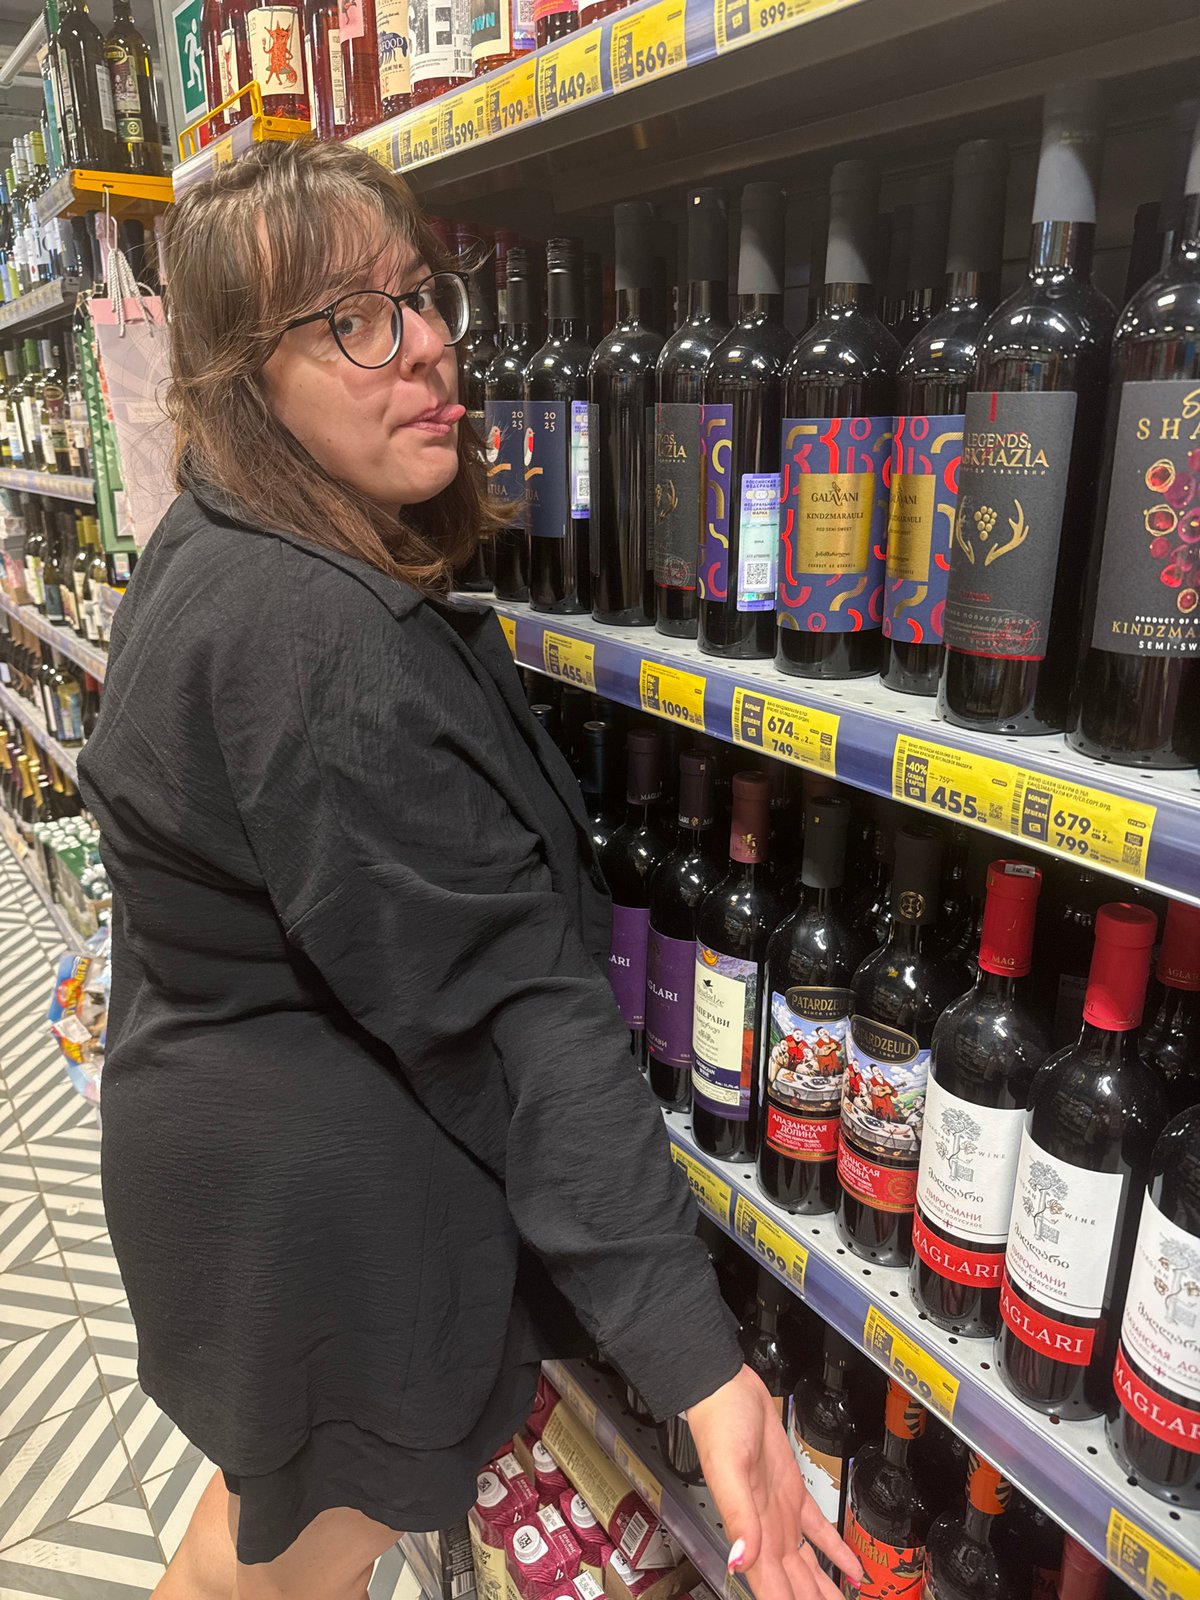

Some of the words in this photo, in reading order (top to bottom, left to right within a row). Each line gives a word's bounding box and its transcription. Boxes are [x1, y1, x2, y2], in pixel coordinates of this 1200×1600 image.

[760, 2, 786, 27] 899
[635, 41, 667, 77] 569
[558, 72, 585, 104] 449
[501, 99, 523, 128] 799
[453, 120, 474, 147] 599
[413, 139, 430, 162] 429
[511, 411, 524, 419] 20
[511, 420, 523, 431] 25
[544, 411, 556, 419] 20
[544, 422, 556, 432] 25
[961, 448, 1049, 468] BKHAZIA
[811, 491, 859, 506] GALAVANI
[806, 512, 864, 521] KINDZMARAULI
[1135, 616, 1175, 624] PRODUCT
[562, 663, 583, 683] 455
[661, 699, 689, 721] 1099
[767, 715, 794, 738] 674
[771, 739, 794, 757] 749
[906, 761, 928, 775] -40%
[931, 785, 977, 819] 455
[1053, 810, 1092, 835] 679
[1055, 832, 1089, 855] 799
[609, 954, 631, 968] ARI
[772, 1112, 828, 1133] АЛАЗАНСКАЯ
[780, 1125, 818, 1140] ДОЛИНА
[978, 1151, 1006, 1160] WINE
[926, 1187, 982, 1223] ПИРОСМАНИ
[1064, 1211, 1097, 1226] WINE
[757, 1239, 787, 1273] 599
[913, 1222, 999, 1279] MAGLARI
[1011, 1242, 1067, 1290] ПИРОСМАНИ
[893, 1355, 932, 1400] 599
